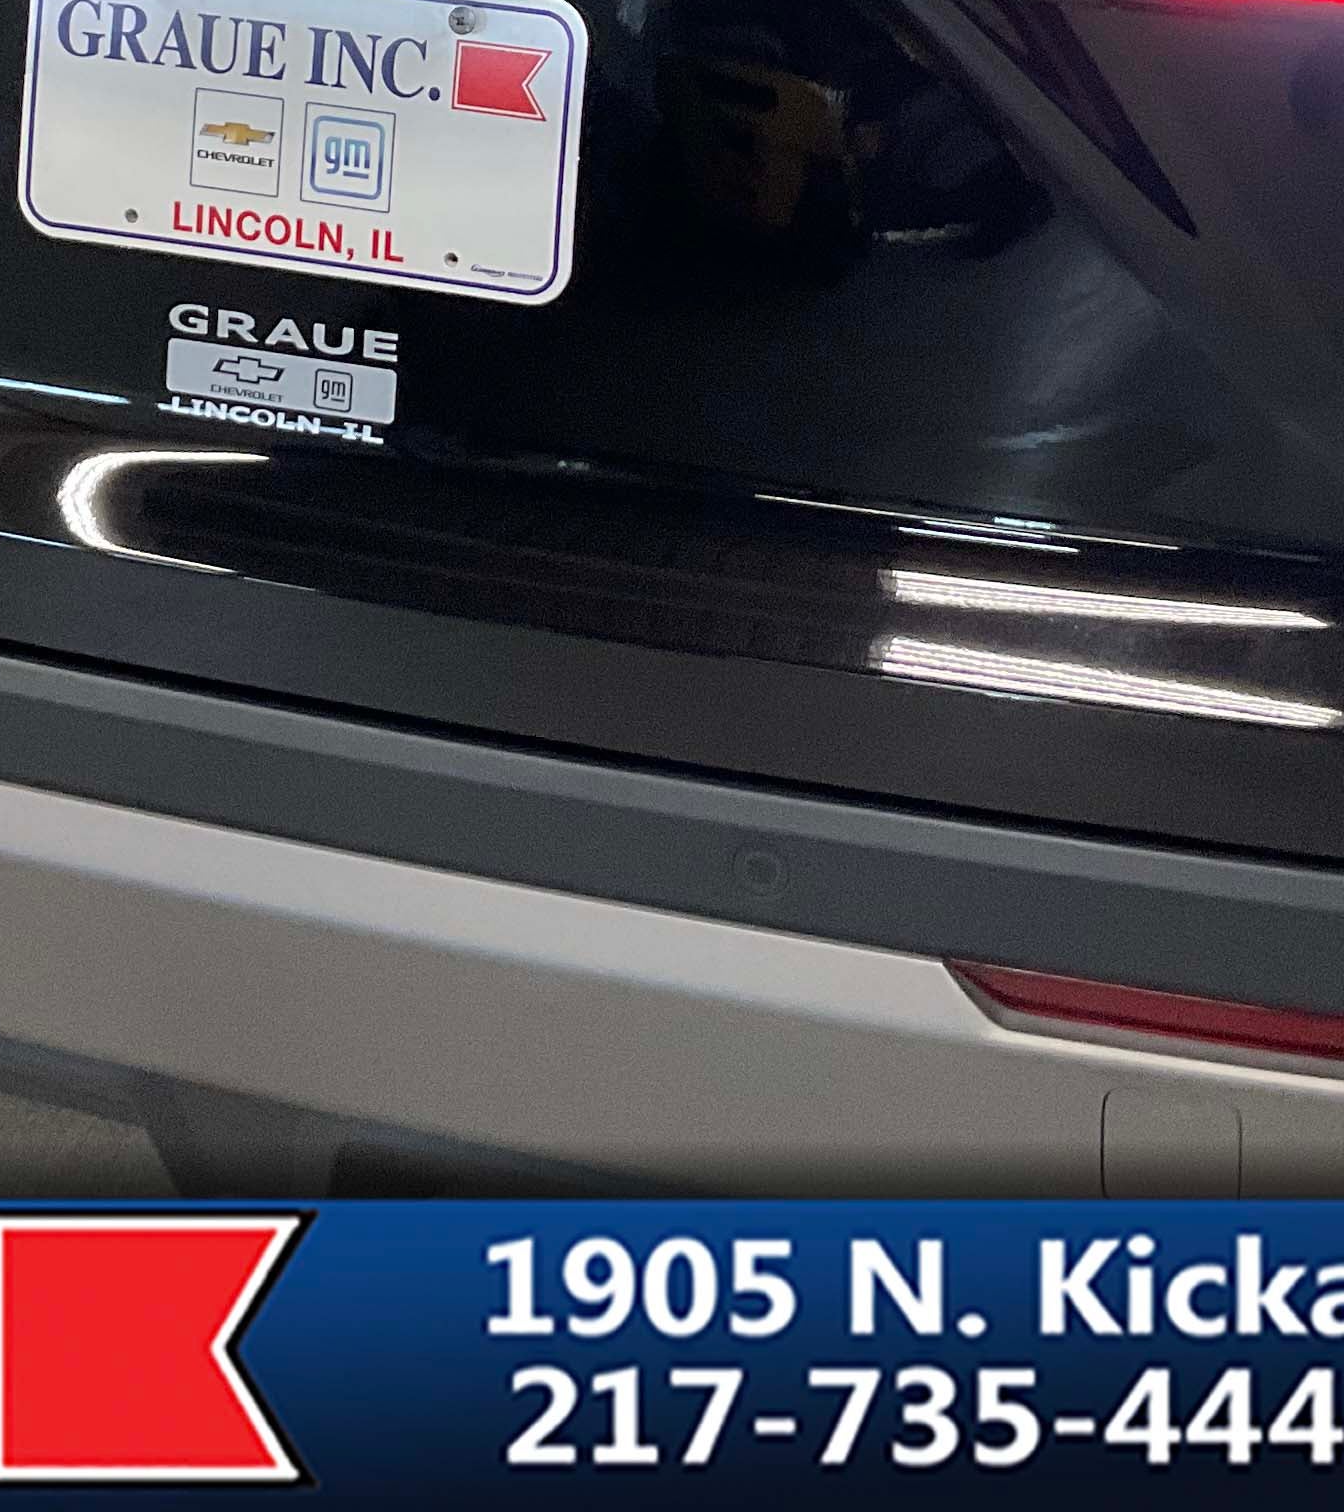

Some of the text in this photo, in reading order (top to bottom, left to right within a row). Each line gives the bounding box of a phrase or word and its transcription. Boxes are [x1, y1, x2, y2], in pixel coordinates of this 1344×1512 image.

[304, 26, 441, 101] INC.
[196, 148, 275, 168] CHEVROLET
[172, 201, 404, 264] LINCOLN, IL
[168, 303, 398, 362] GRAUE
[210, 383, 283, 403] CHEVROLET
[342, 422, 384, 445] IL
